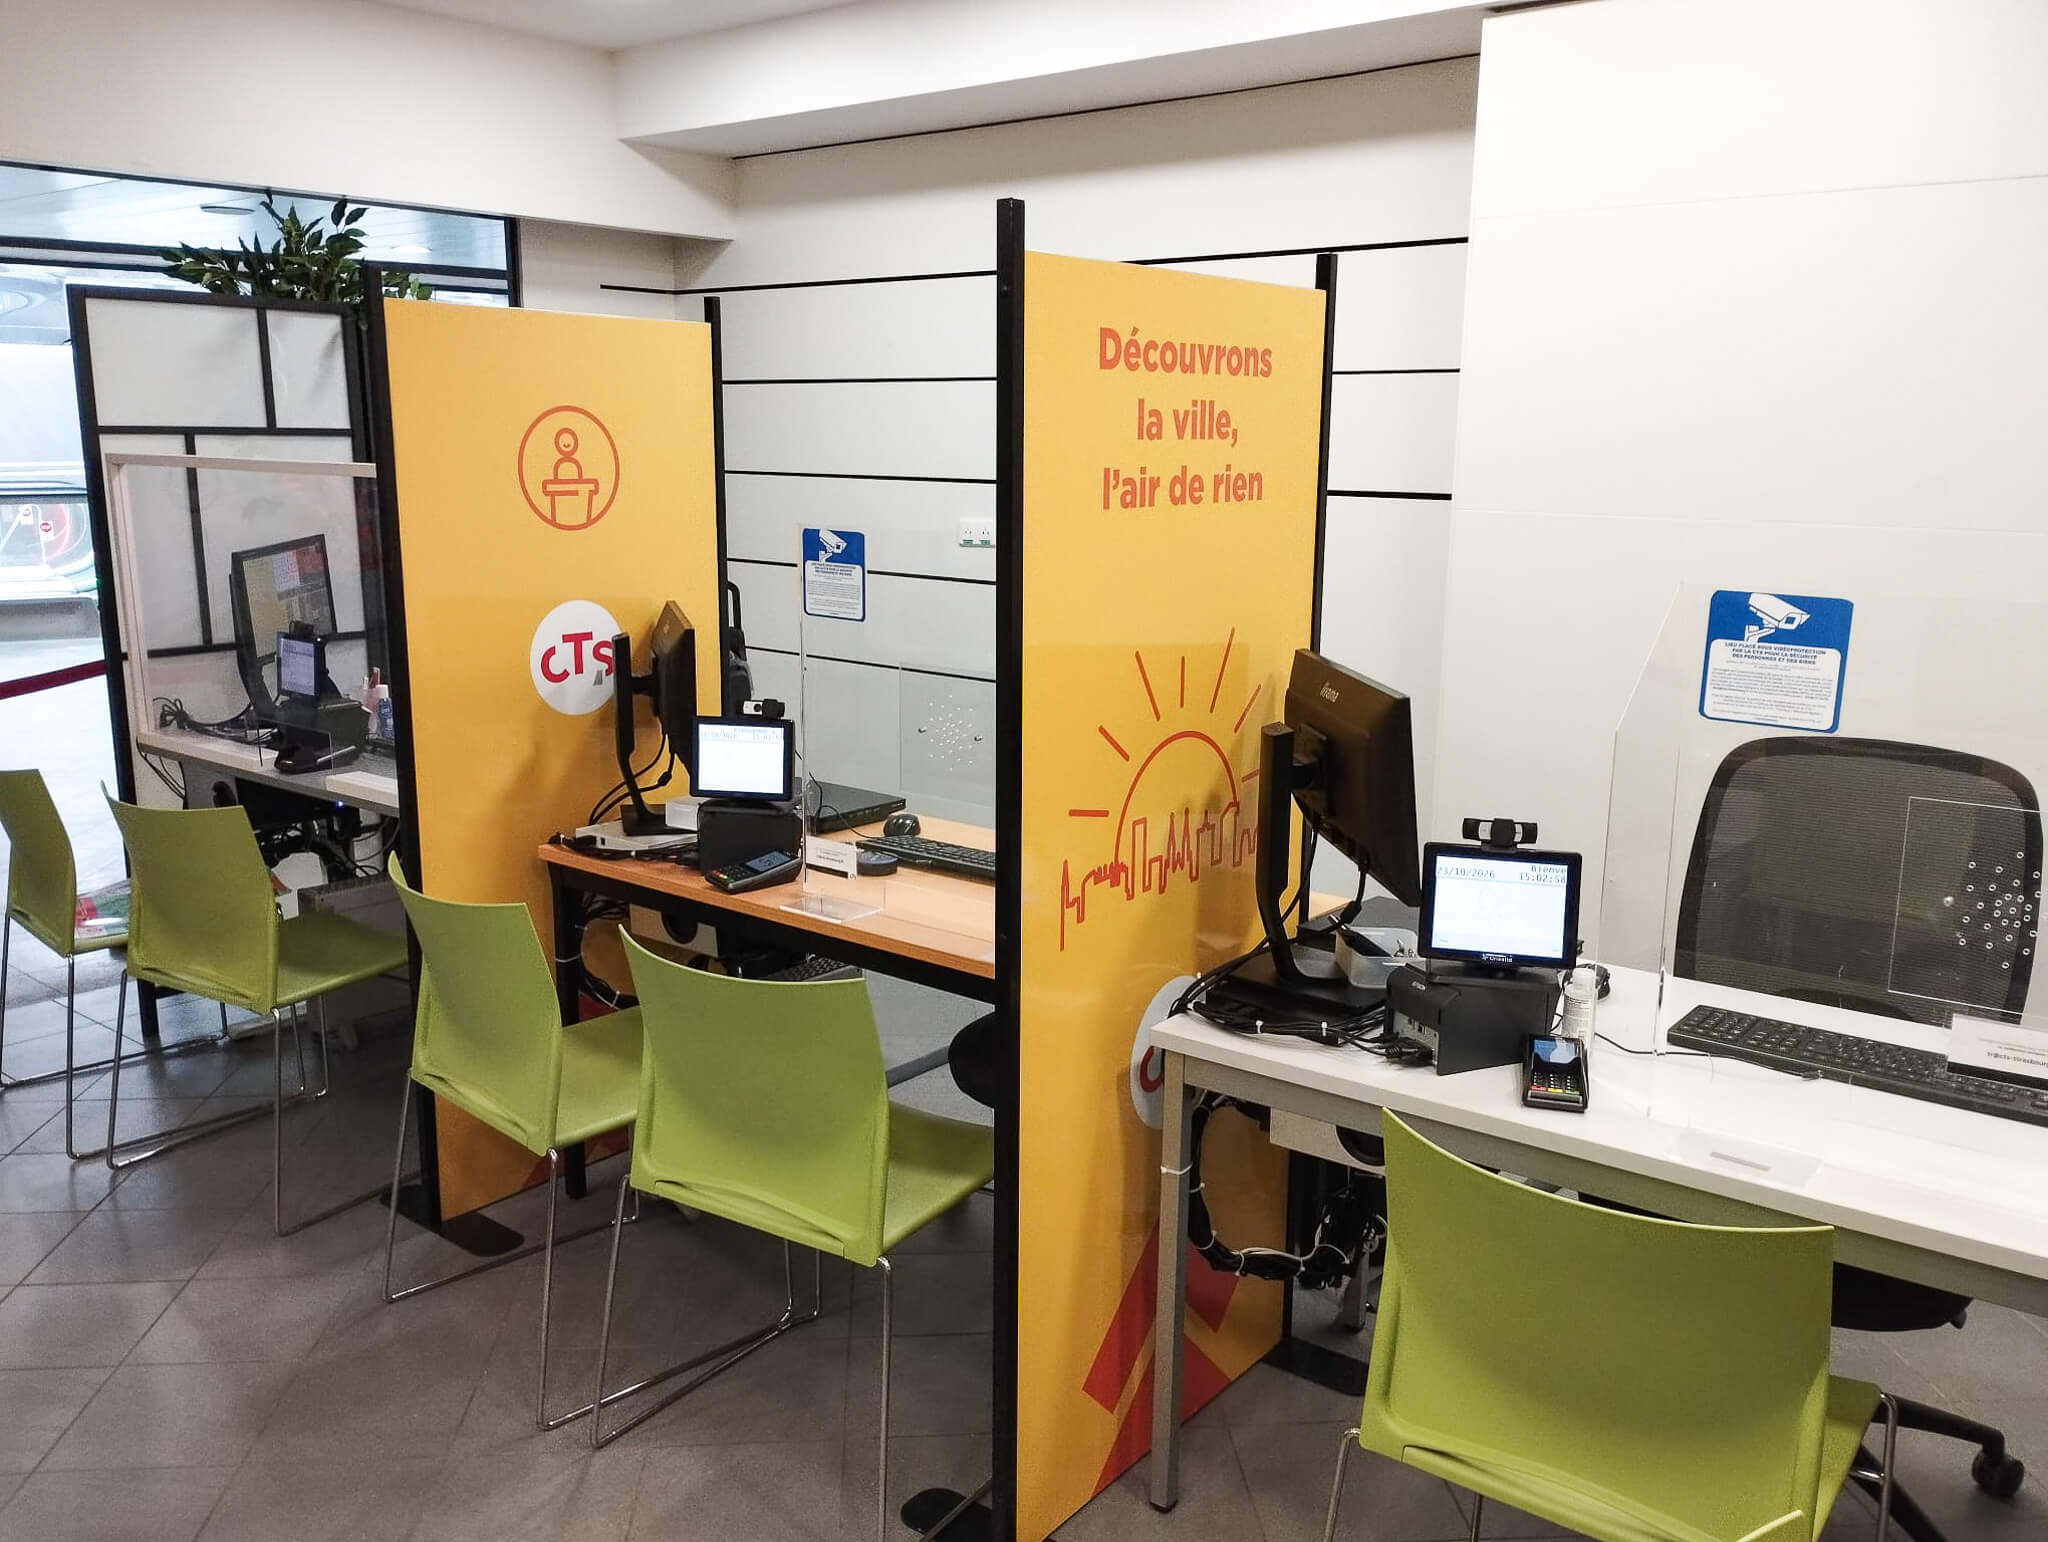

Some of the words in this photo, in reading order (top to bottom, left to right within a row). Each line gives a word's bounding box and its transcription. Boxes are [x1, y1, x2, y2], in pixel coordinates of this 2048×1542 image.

[1099, 326, 1273, 378] Découvrons
[1137, 398, 1163, 440] la
[1172, 399, 1238, 448] ville,
[1103, 466, 1160, 510] l'air
[1169, 465, 1204, 506] de
[1212, 464, 1263, 504] rien
[540, 631, 614, 684] CTS
